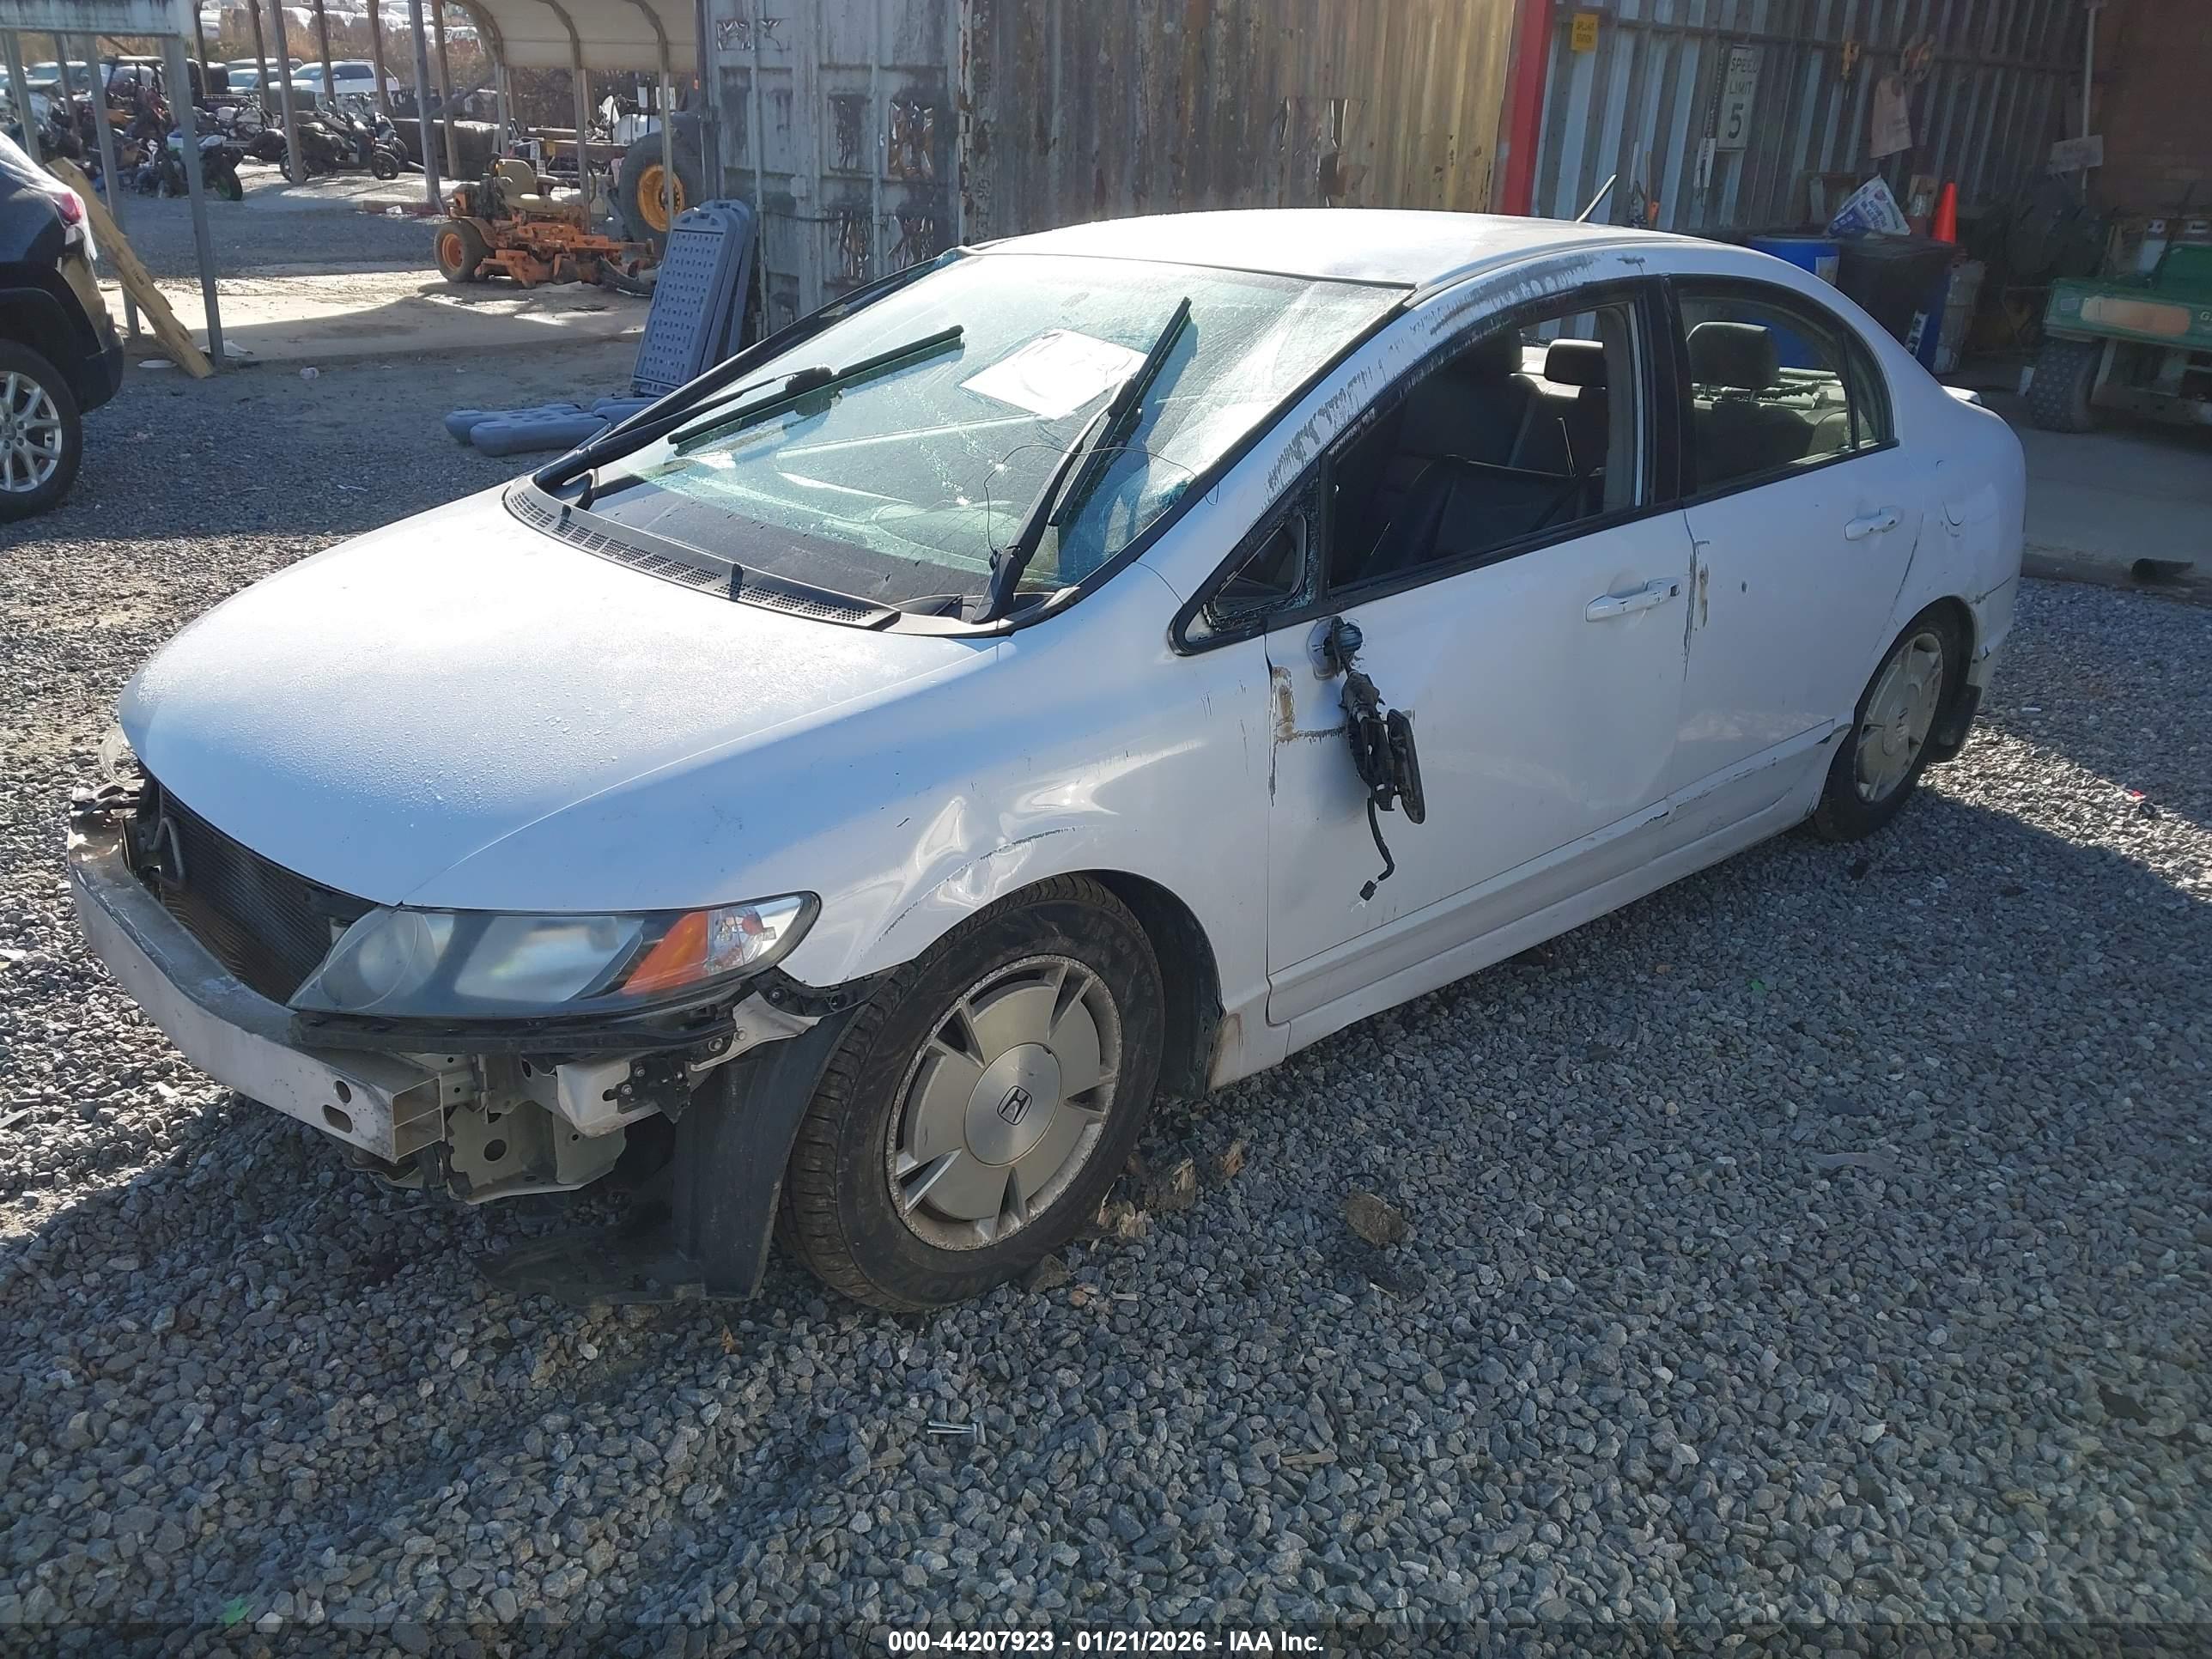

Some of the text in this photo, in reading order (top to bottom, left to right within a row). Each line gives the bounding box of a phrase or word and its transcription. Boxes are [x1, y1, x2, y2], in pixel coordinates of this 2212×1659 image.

[1730, 56, 1759, 73] SPEED
[1729, 81, 1753, 95] LIMIT
[1728, 102, 1744, 139] 5
